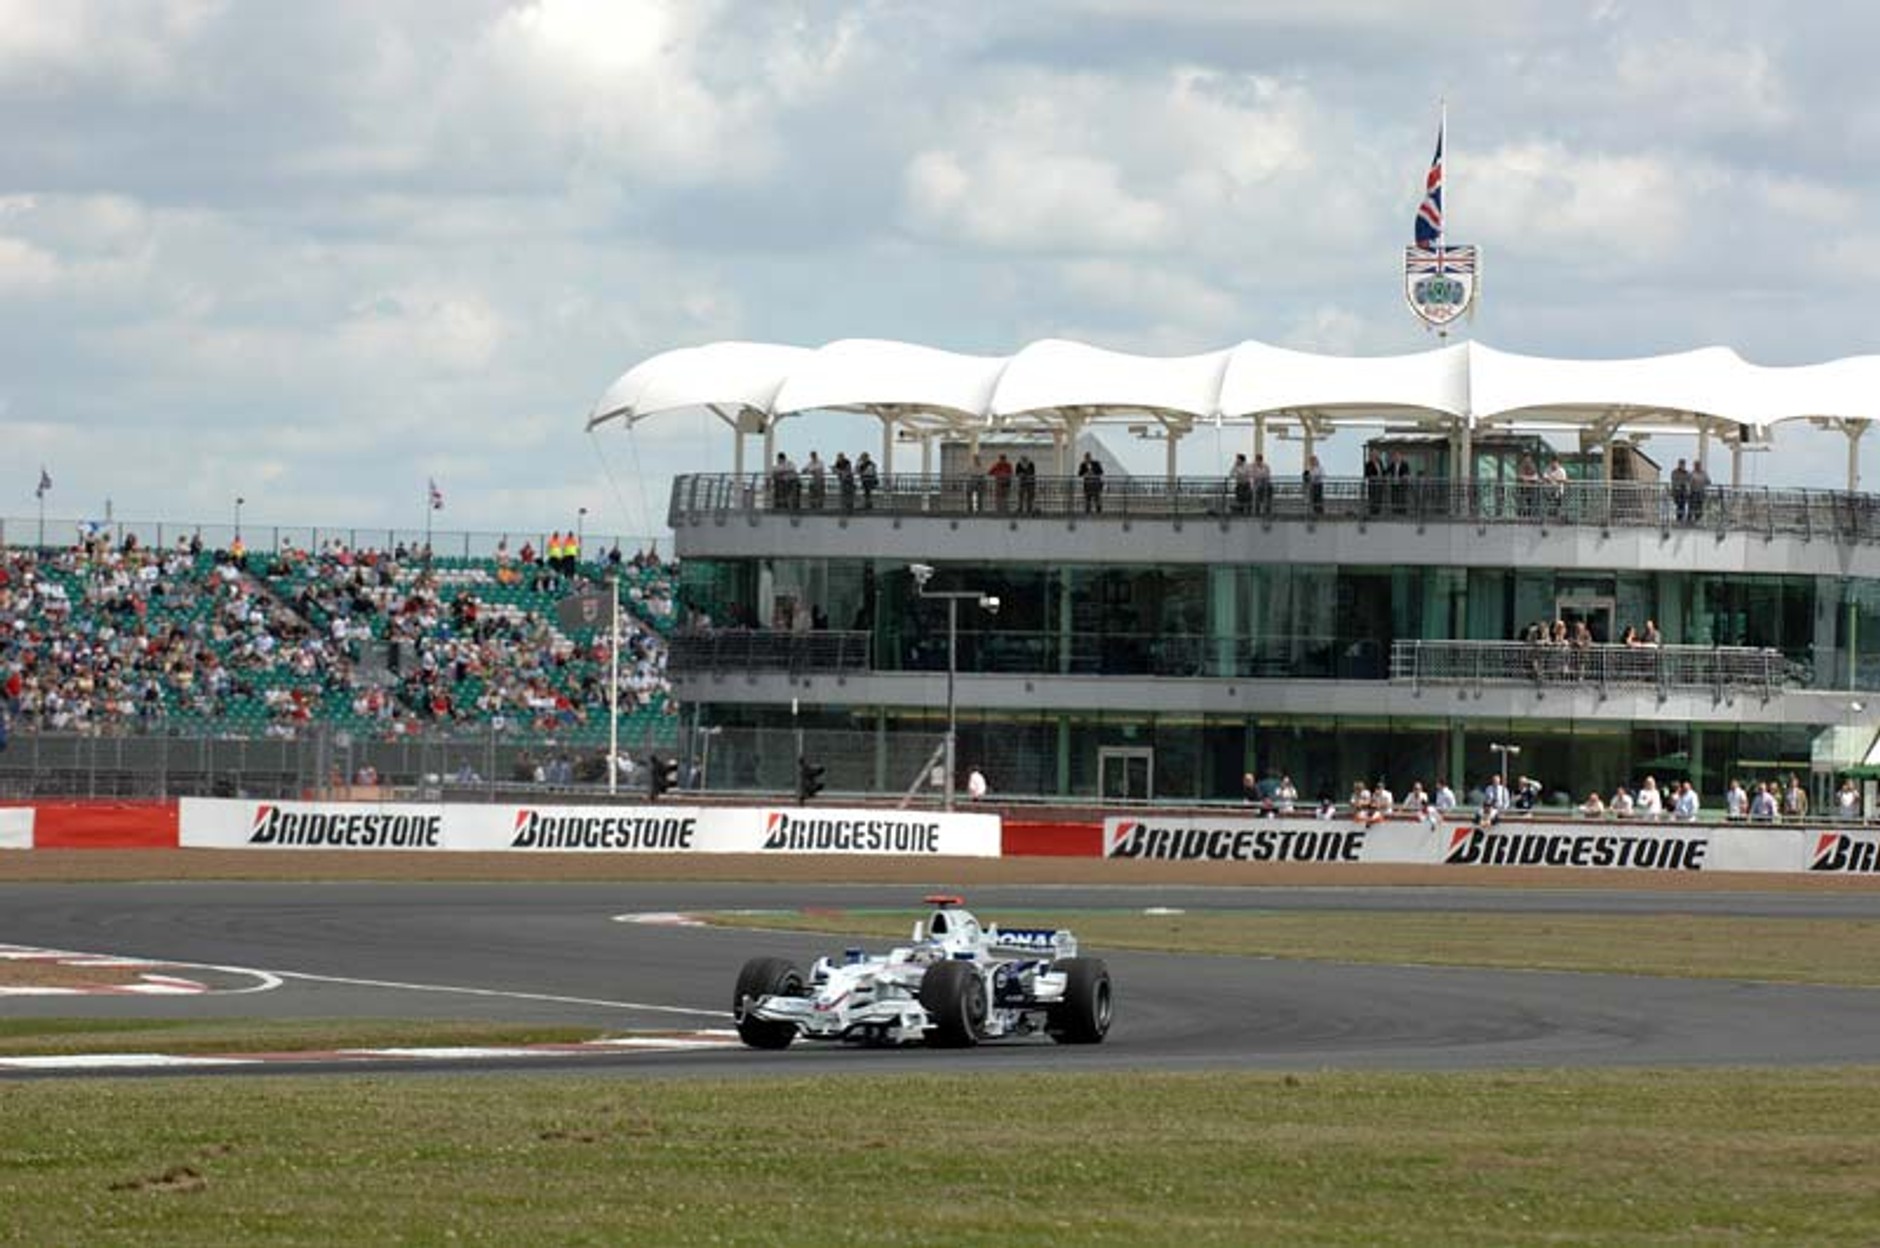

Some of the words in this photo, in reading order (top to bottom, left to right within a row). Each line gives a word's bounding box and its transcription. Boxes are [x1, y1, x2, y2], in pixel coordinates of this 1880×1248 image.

[249, 806, 441, 847] BRIDGESTONE
[511, 810, 697, 848] BRIDGESTONE
[763, 812, 938, 852] BRIDGESTONE
[1108, 823, 1365, 861] BRIDGESTONE
[1445, 828, 1708, 870] BRIDGESTONE
